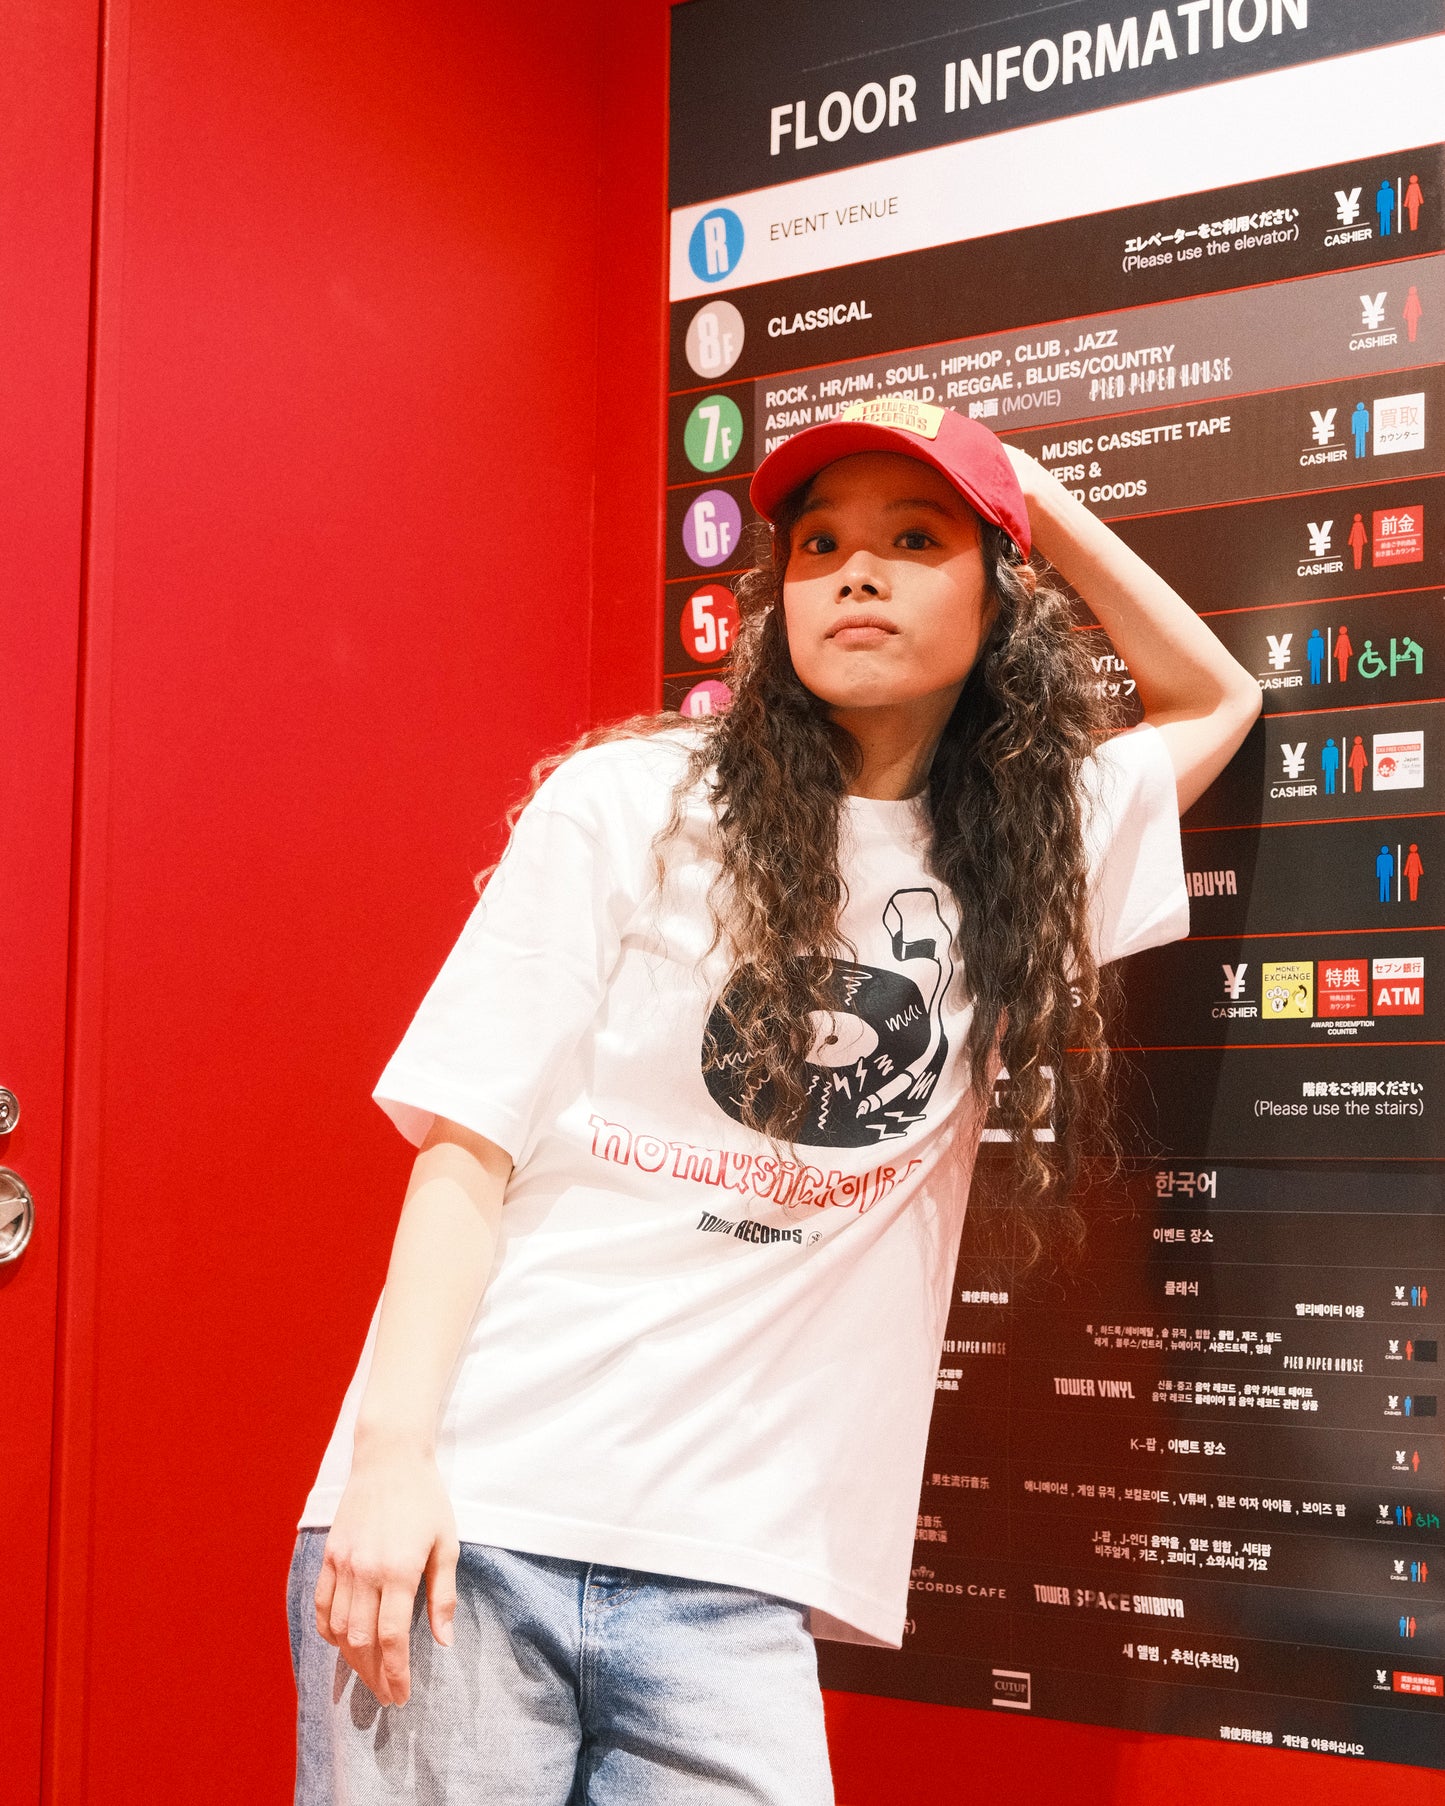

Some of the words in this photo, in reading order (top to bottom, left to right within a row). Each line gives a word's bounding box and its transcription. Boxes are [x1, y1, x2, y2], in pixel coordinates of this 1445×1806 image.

[770, 74, 917, 156] FLOOR
[944, 0, 1307, 113] INFORMATION
[770, 213, 829, 241] EVENT
[836, 196, 899, 226] VENUE
[1125, 208, 1299, 253] エレベーターをご利用ください
[1324, 228, 1372, 247] CASHIER
[704, 216, 729, 276] R
[1122, 252, 1173, 273] (Please
[1177, 247, 1202, 261] use
[1206, 240, 1230, 257] the
[1235, 223, 1300, 251] elevator)
[767, 300, 872, 338] CLASSICAL
[697, 313, 733, 370] 8F
[1349, 334, 1397, 351] CASHIER
[765, 385, 808, 408] ROCK
[820, 373, 874, 399] HR/HM
[885, 364, 929, 386] SOUL
[940, 351, 1002, 376] HIPHOP
[1014, 340, 1061, 363] CLUB
[1073, 329, 1118, 353] JAZZ
[1089, 374, 1126, 401] PIED
[1129, 366, 1175, 396] PIPER
[1180, 357, 1233, 387] HOUSE
[765, 407, 812, 432] ASIAN
[947, 372, 1013, 399] REGGAE
[1026, 344, 1175, 386] BLUES/COUNTRY
[862, 402, 919, 415] TOWER
[969, 398, 999, 419] 映画
[1002, 389, 1061, 415] (MOVIE)
[1380, 406, 1418, 430] 買取
[699, 404, 733, 464] 7F
[1042, 438, 1093, 462] MUSIC
[1097, 424, 1183, 452] CASSETTE
[1186, 416, 1231, 439] TAPE
[1379, 431, 1419, 443] カウンター
[1300, 450, 1347, 466] CASHIER
[1089, 461, 1102, 478] &
[1089, 480, 1147, 503] GOODS
[693, 500, 731, 559] 6F
[1381, 513, 1415, 536] 前金
[1297, 561, 1343, 577] CASHIER
[691, 595, 729, 654] 5F
[1257, 675, 1303, 690] CASHIER
[1270, 785, 1317, 799] CASHIER
[1264, 973, 1311, 982] EXCHANGE
[1325, 967, 1360, 988] 特典
[1375, 963, 1421, 974] セブン銀行
[1377, 987, 1420, 1006] ATM
[1212, 1007, 1257, 1019] CASHIER
[1311, 1021, 1334, 1029] AWARD
[1335, 1020, 1375, 1028] REDEMPTION
[1327, 1028, 1358, 1036] COUNTER
[1302, 1081, 1424, 1097] 階段をご利用ください
[1254, 1100, 1308, 1117] (Please
[1313, 1103, 1340, 1116] use
[1344, 1101, 1370, 1116] the
[1375, 1099, 1424, 1117] stairs)
[1155, 1171, 1217, 1199] 한국어
[734, 1219, 803, 1245] RECORDS
[1153, 1228, 1186, 1243] 이벤트
[1190, 1228, 1214, 1243] 장소
[1164, 1281, 1199, 1296] 클래식
[1345, 1305, 1365, 1318] 이용
[1054, 1378, 1095, 1396] TOWER
[1098, 1380, 1135, 1399] VINYL
[1130, 1438, 1157, 1452] K-팝
[1168, 1439, 1200, 1454] 이벤트
[1204, 1441, 1226, 1456] 장소
[932, 1473, 990, 1489] 男生流行音乐
[1024, 1480, 1068, 1495] 애니메이션
[1077, 1484, 1095, 1497] 게임
[1098, 1486, 1116, 1499] 뮤직
[1124, 1488, 1170, 1503] 보컬로이드
[1179, 1493, 1207, 1507] V튜버
[1217, 1495, 1236, 1508] 일본
[1239, 1497, 1259, 1511] 여자
[1262, 1498, 1292, 1513] 아이돌
[1302, 1502, 1333, 1515] 보이즈
[1335, 1504, 1346, 1517] 팝
[1189, 1538, 1209, 1552] 일본
[1212, 1540, 1232, 1554] 힙합
[1242, 1542, 1272, 1557] 시티팝
[1139, 1549, 1158, 1562] 키즈
[1167, 1551, 1196, 1566] 코미디
[1206, 1555, 1244, 1570] 쇼와시대
[1248, 1558, 1268, 1571] 가요
[1034, 1584, 1070, 1606] TOWER
[1073, 1588, 1131, 1612] SPACE
[1132, 1595, 1185, 1618] SHIBUYA
[1122, 1643, 1134, 1659] 새
[1137, 1645, 1159, 1662] 앨범
[1171, 1648, 1240, 1673] 추천(추천판)
[1282, 1734, 1309, 1749] 계단을
[1311, 1738, 1365, 1756] 이용하십시오
